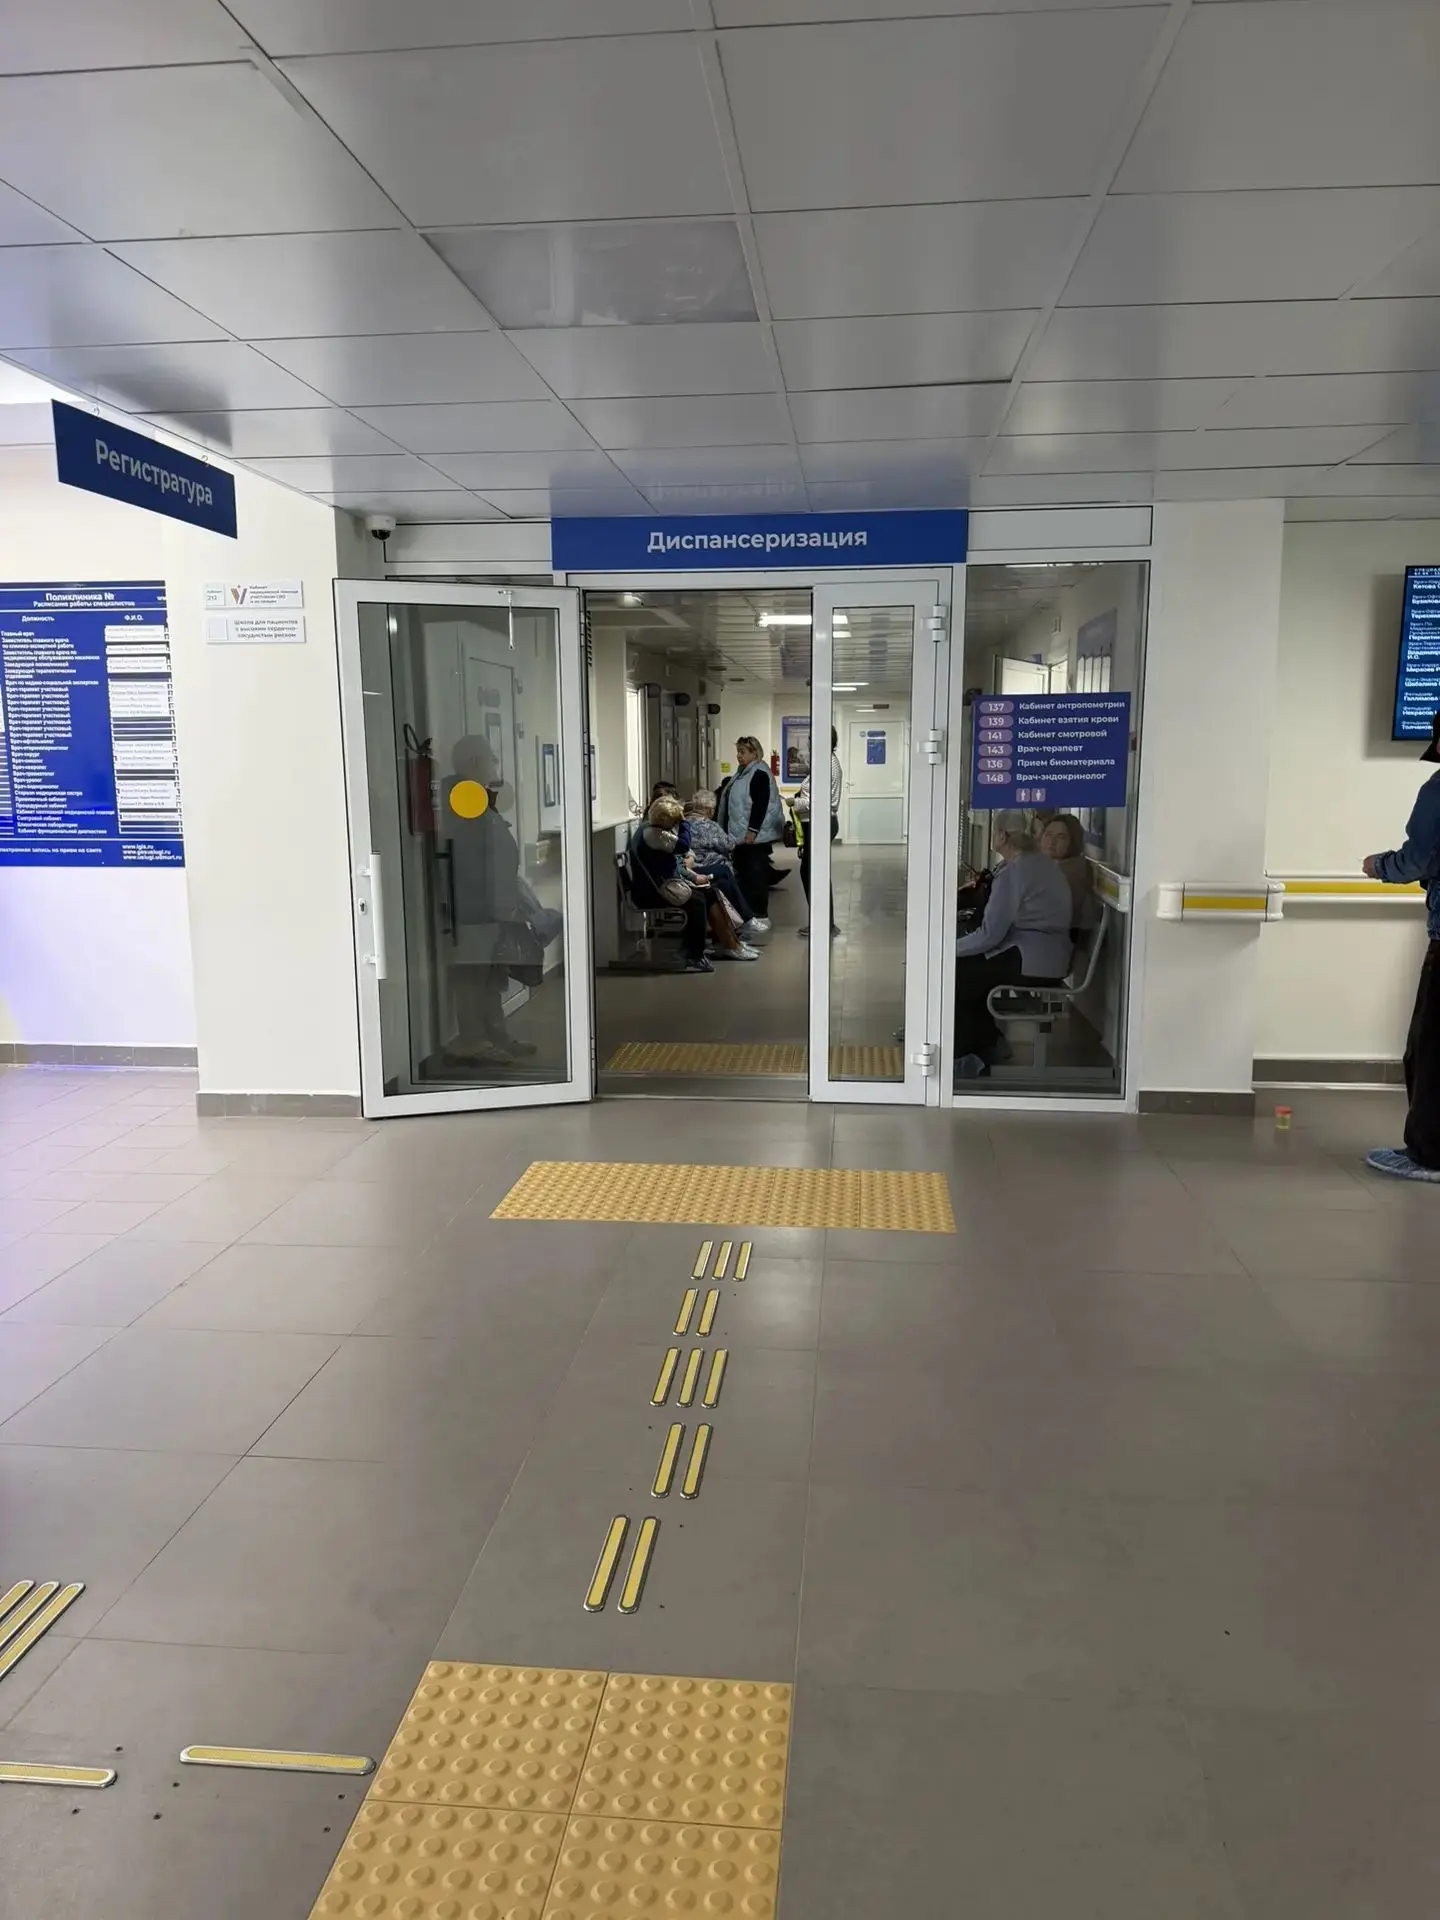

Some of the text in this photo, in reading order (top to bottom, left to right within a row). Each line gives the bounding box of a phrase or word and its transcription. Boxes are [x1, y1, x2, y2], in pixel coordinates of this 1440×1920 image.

[95, 438, 213, 506] Регистратура
[647, 531, 868, 553] Диспансеризация
[46, 593, 103, 601] Поликлиника
[989, 701, 1126, 712] 137 Кабинет антропометрии
[988, 715, 1120, 726] 139 Кабинет взятия крови
[988, 729, 1108, 740] 141 Кабинет смотровой
[987, 744, 1084, 754] 143 Врач-терапевт
[987, 757, 1116, 769] 136 Прием биоматериала
[986, 772, 1107, 783] 148 Врач-эндокринолог
